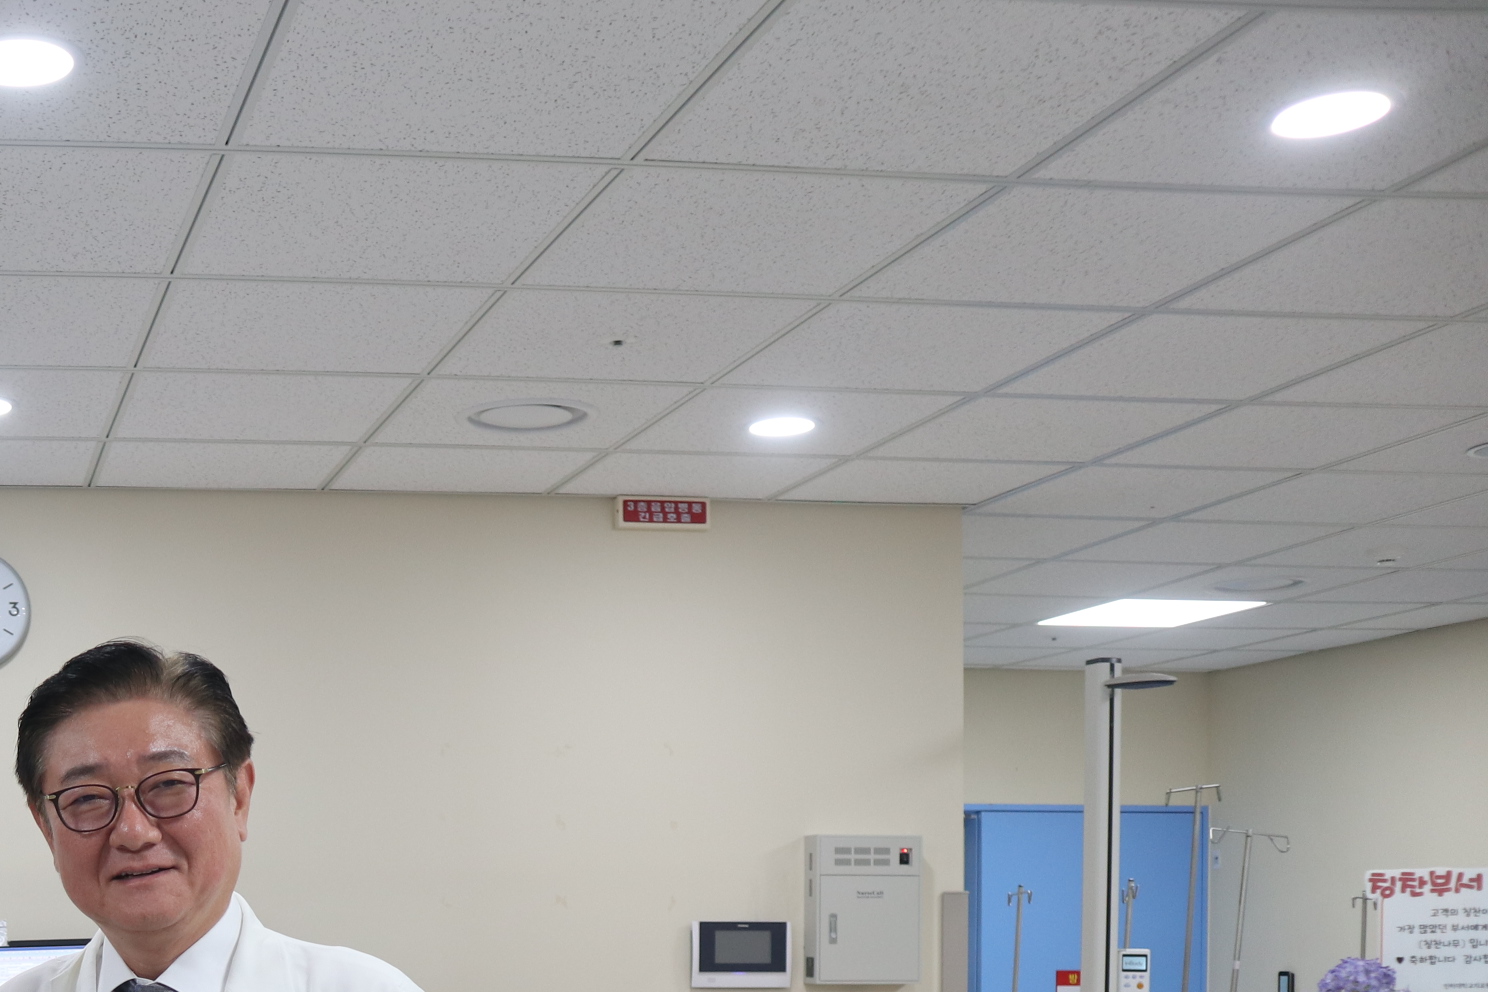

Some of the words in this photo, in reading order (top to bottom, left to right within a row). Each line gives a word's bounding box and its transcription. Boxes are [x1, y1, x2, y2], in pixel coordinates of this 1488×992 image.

[9, 602, 19, 616] 3
[1368, 870, 1483, 898] 칭찬부서
[1431, 908, 1458, 917] 고객의
